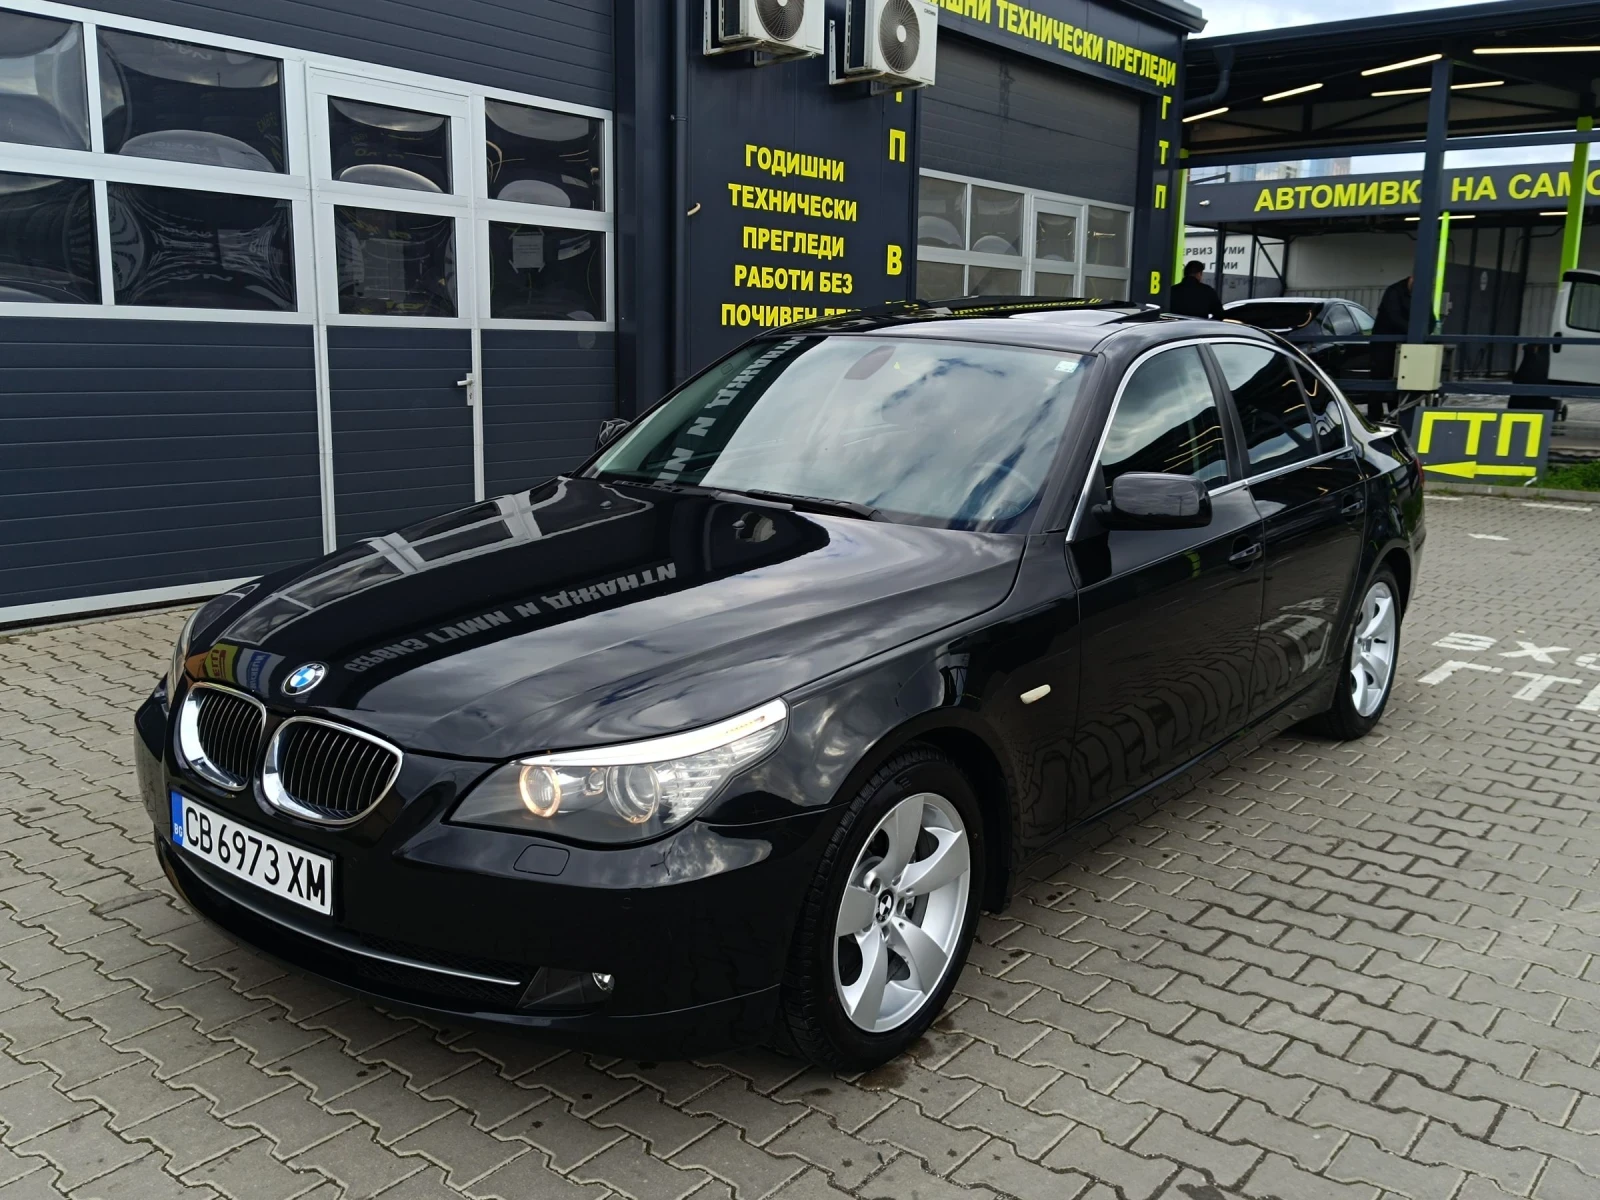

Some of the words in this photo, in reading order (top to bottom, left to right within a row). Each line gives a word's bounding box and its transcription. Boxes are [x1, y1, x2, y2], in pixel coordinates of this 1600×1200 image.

[996, 0, 1104, 63] ТЕХНИЧЕСКИ
[1106, 40, 1177, 88] ПРЕГЛЕДИ
[745, 144, 845, 183] ГОДИШНИ
[728, 183, 857, 222] ТЕХНИЧЕСКИ
[1255, 180, 1422, 212] АВТОМИВК
[1451, 176, 1498, 202] НА
[743, 226, 845, 261] ПРЕГЛЕДИ
[734, 265, 814, 292] РАБОТИ
[819, 272, 853, 295] БЕЗ
[1417, 411, 1544, 458] ГТП
[174, 823, 184, 837] BG
